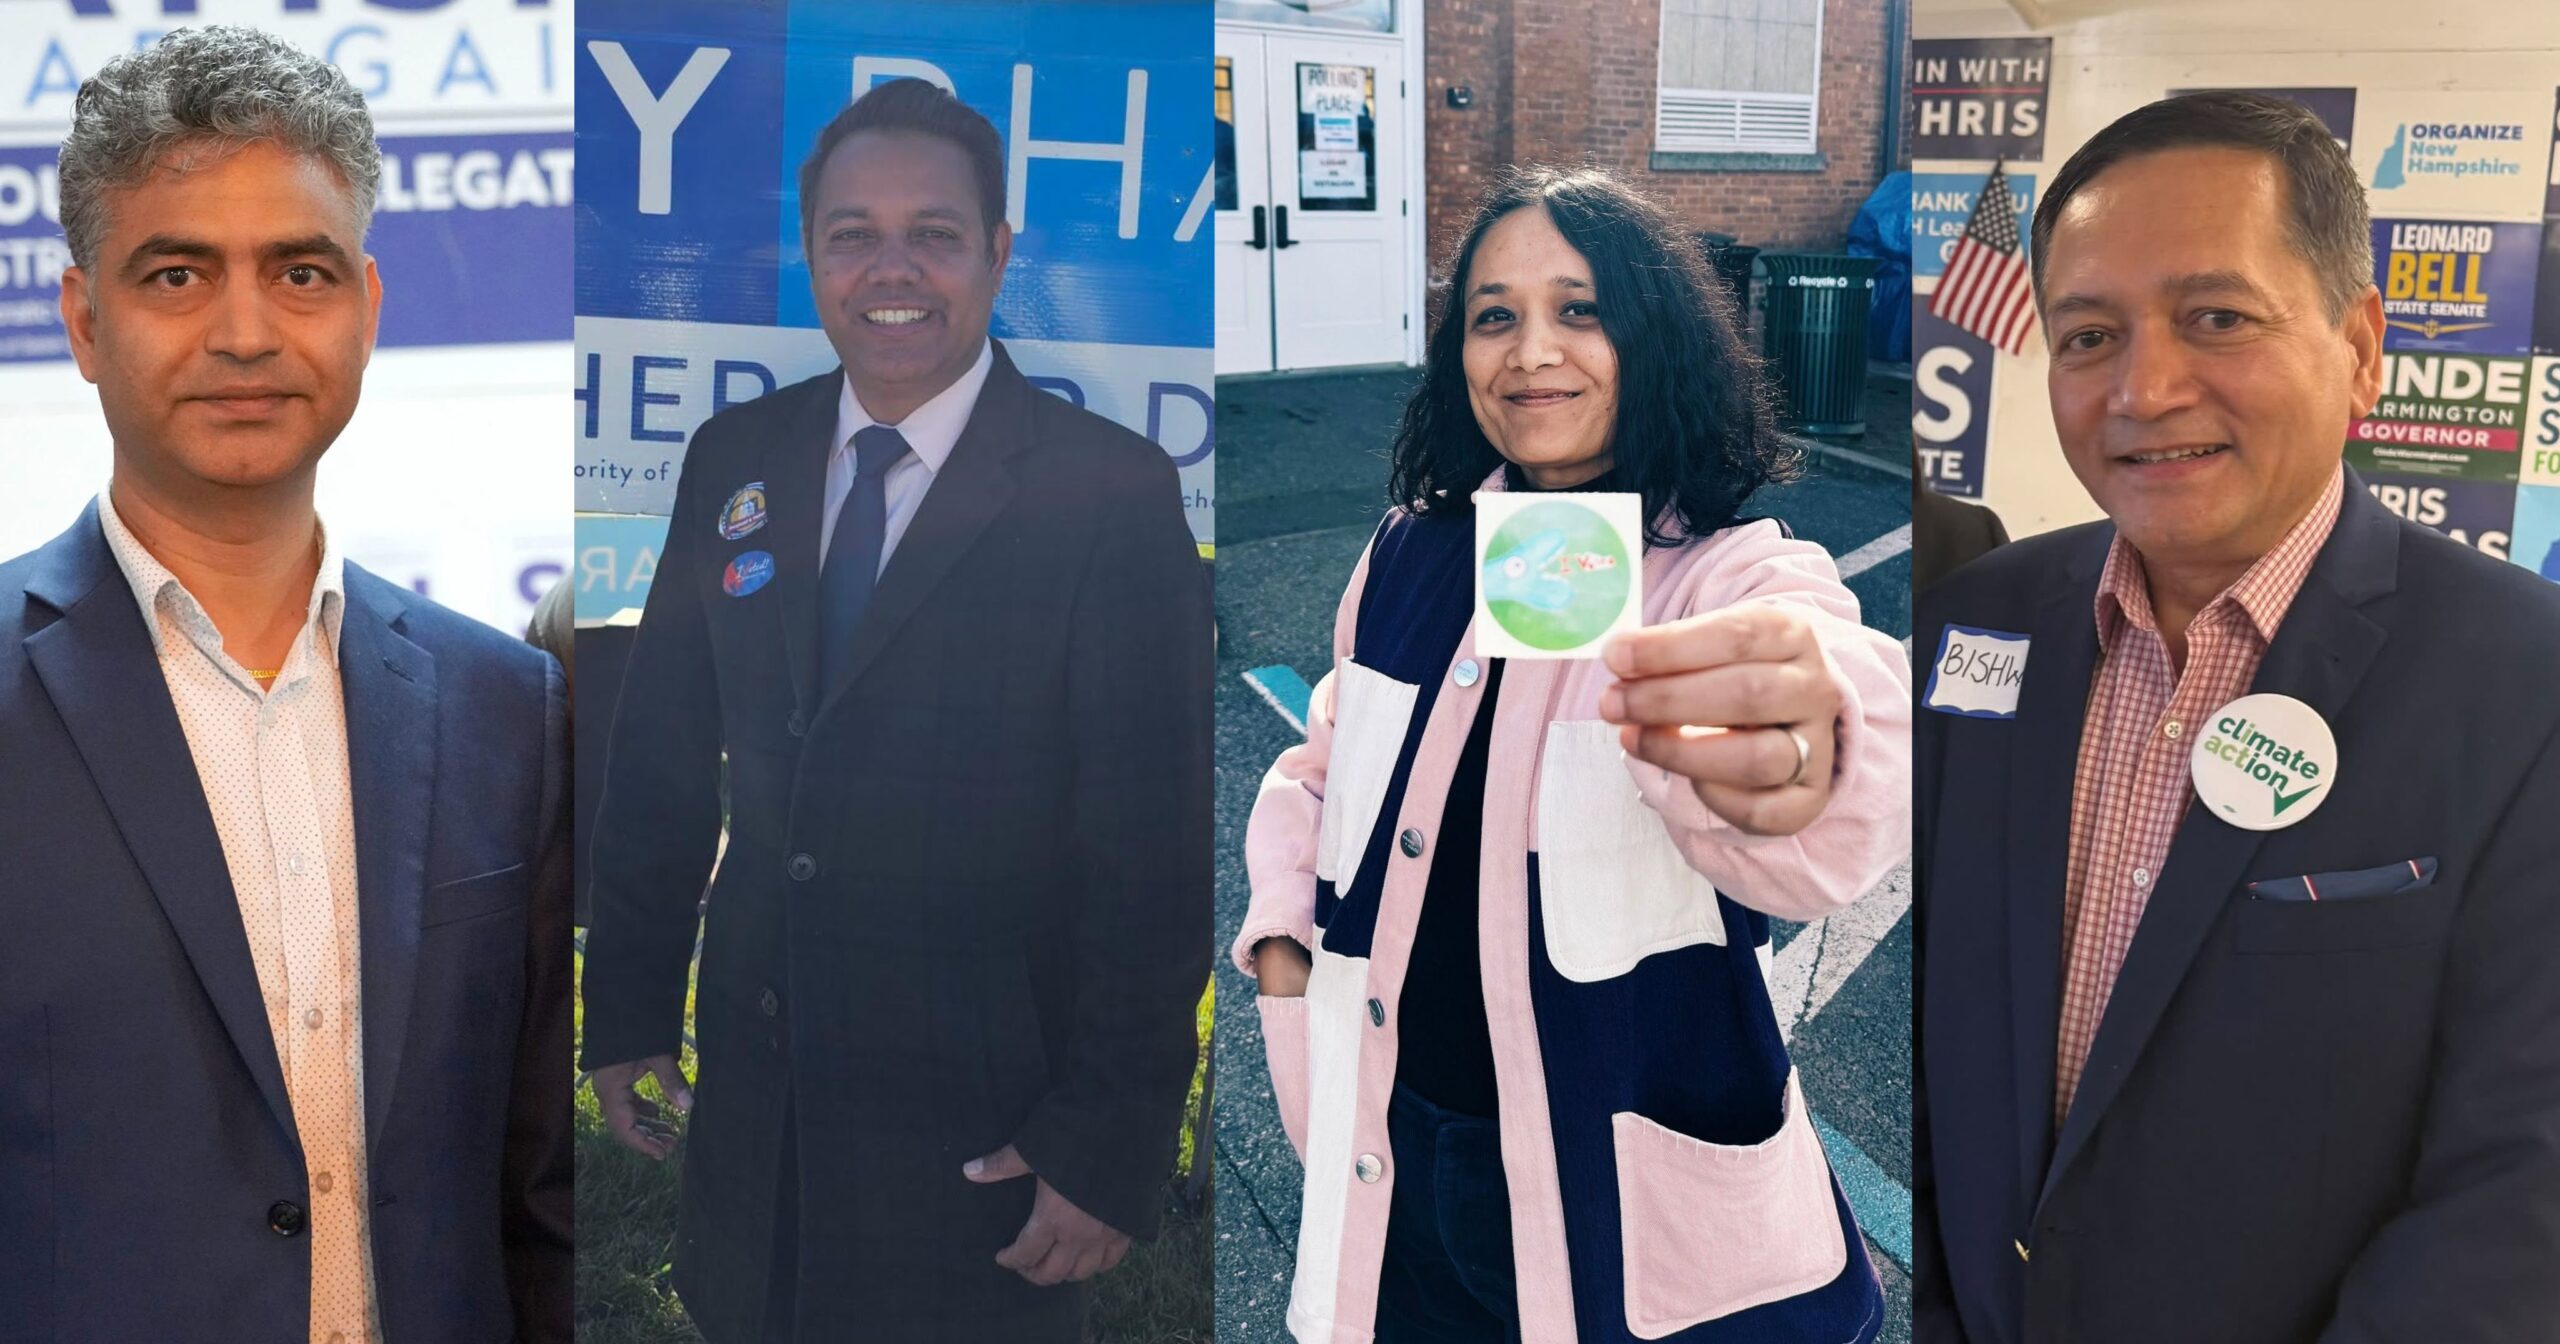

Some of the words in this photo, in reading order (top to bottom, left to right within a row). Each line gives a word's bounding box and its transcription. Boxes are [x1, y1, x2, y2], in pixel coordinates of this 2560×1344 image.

[1308, 68, 1358, 88] POLLING
[1958, 58, 2046, 82] WITH
[1316, 94, 1352, 111] PLACE
[1912, 99, 2041, 137] HRIS
[2410, 124, 2524, 141] ORGANIZE
[2410, 142, 2458, 157] New
[2408, 158, 2520, 177] Hampshire
[2390, 223, 2493, 253] LEONARD
[1798, 275, 1837, 289] Recycle
[2385, 251, 2489, 304] BELL
[2384, 300, 2428, 316] STATE
[2429, 301, 2487, 318] SENATE
[2358, 421, 2491, 448] GOVERNOR
[644, 461, 672, 481] of
[2218, 716, 2321, 780] climate
[2204, 734, 2290, 792] action
